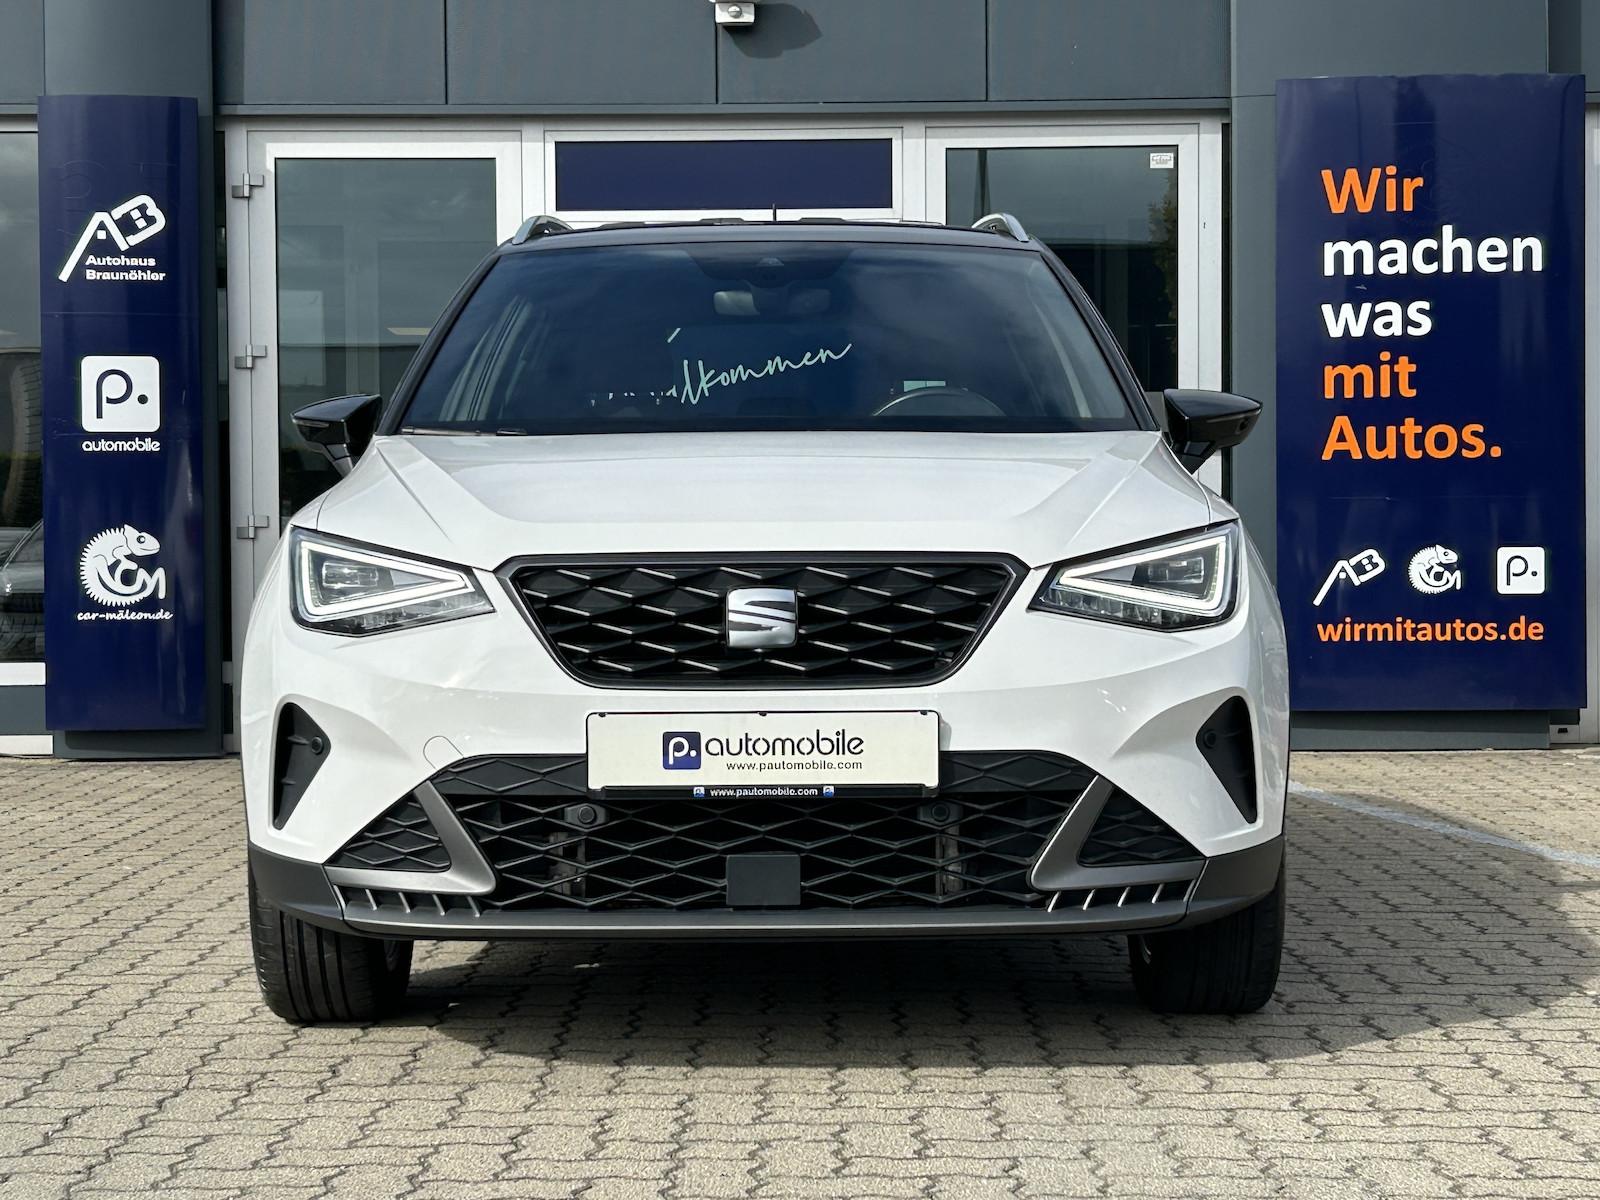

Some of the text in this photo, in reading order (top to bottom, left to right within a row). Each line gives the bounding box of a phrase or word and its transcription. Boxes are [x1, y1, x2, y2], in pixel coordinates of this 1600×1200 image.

[1321, 165, 1424, 214] Wir
[85, 254, 157, 267] Autohaus
[1323, 225, 1544, 276] machen
[85, 269, 166, 282] Braunöhler
[1321, 300, 1433, 338] was
[1323, 351, 1417, 399] mit
[82, 437, 161, 452] automobile
[1321, 415, 1503, 461] Autos.
[1317, 615, 1545, 642] wirmitautos.de
[704, 729, 865, 756] automobile
[726, 759, 863, 772] www.pautomobile.com
[710, 786, 818, 798] www.pautomobile.com
